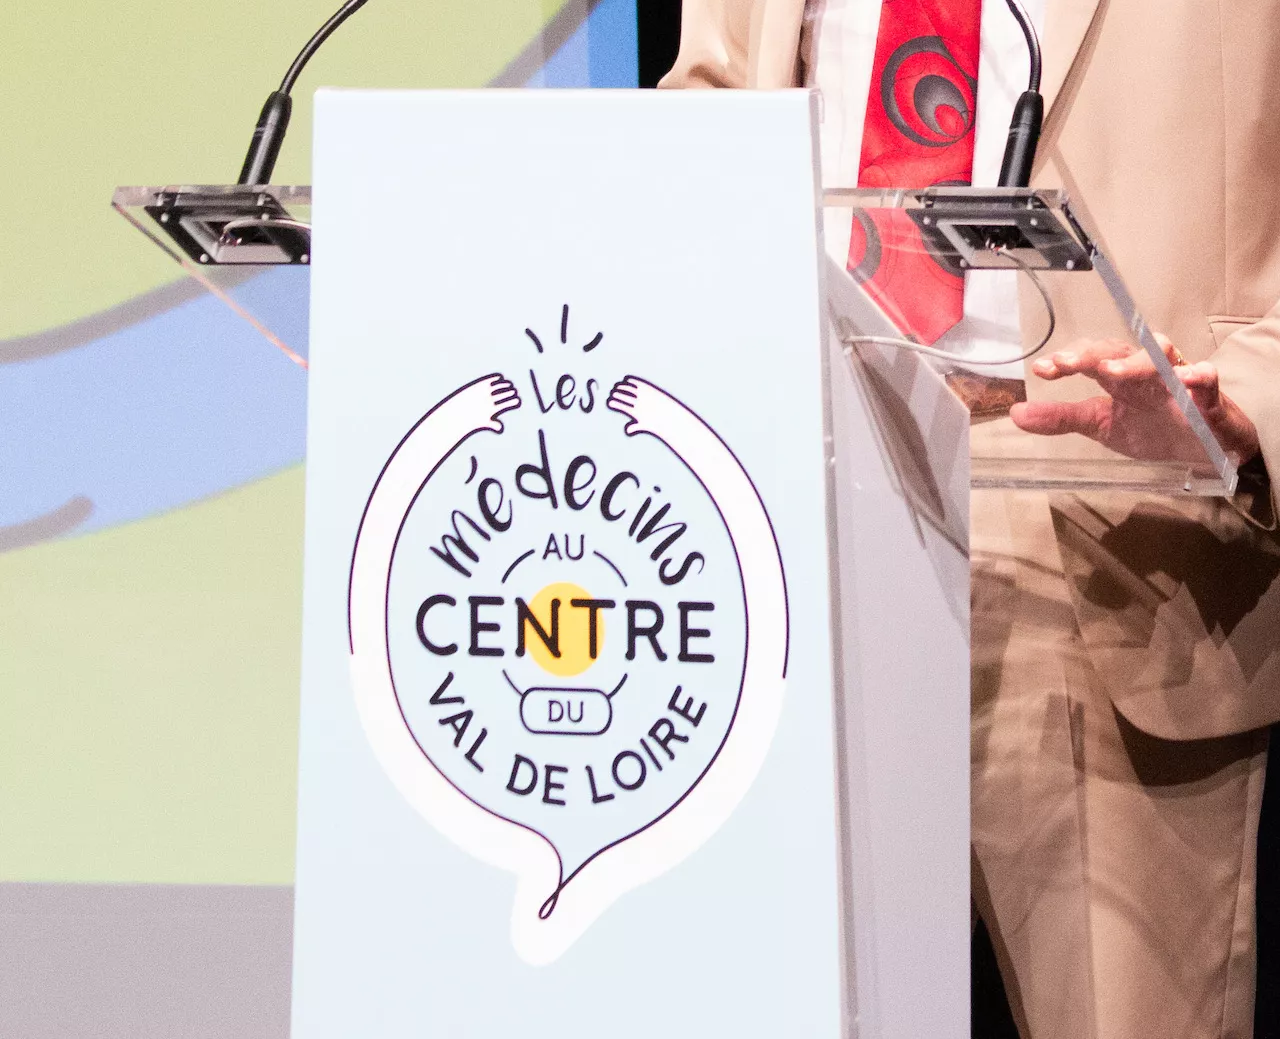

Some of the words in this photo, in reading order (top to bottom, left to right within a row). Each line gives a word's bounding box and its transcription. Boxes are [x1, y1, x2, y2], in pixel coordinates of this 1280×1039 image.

[430, 429, 705, 586] médecins
[542, 533, 586, 561] AU
[415, 593, 716, 663] CENTRE
[429, 671, 488, 772] VAL
[505, 753, 568, 806] DE
[586, 684, 708, 805] LOIRE
[547, 700, 584, 724] DU
